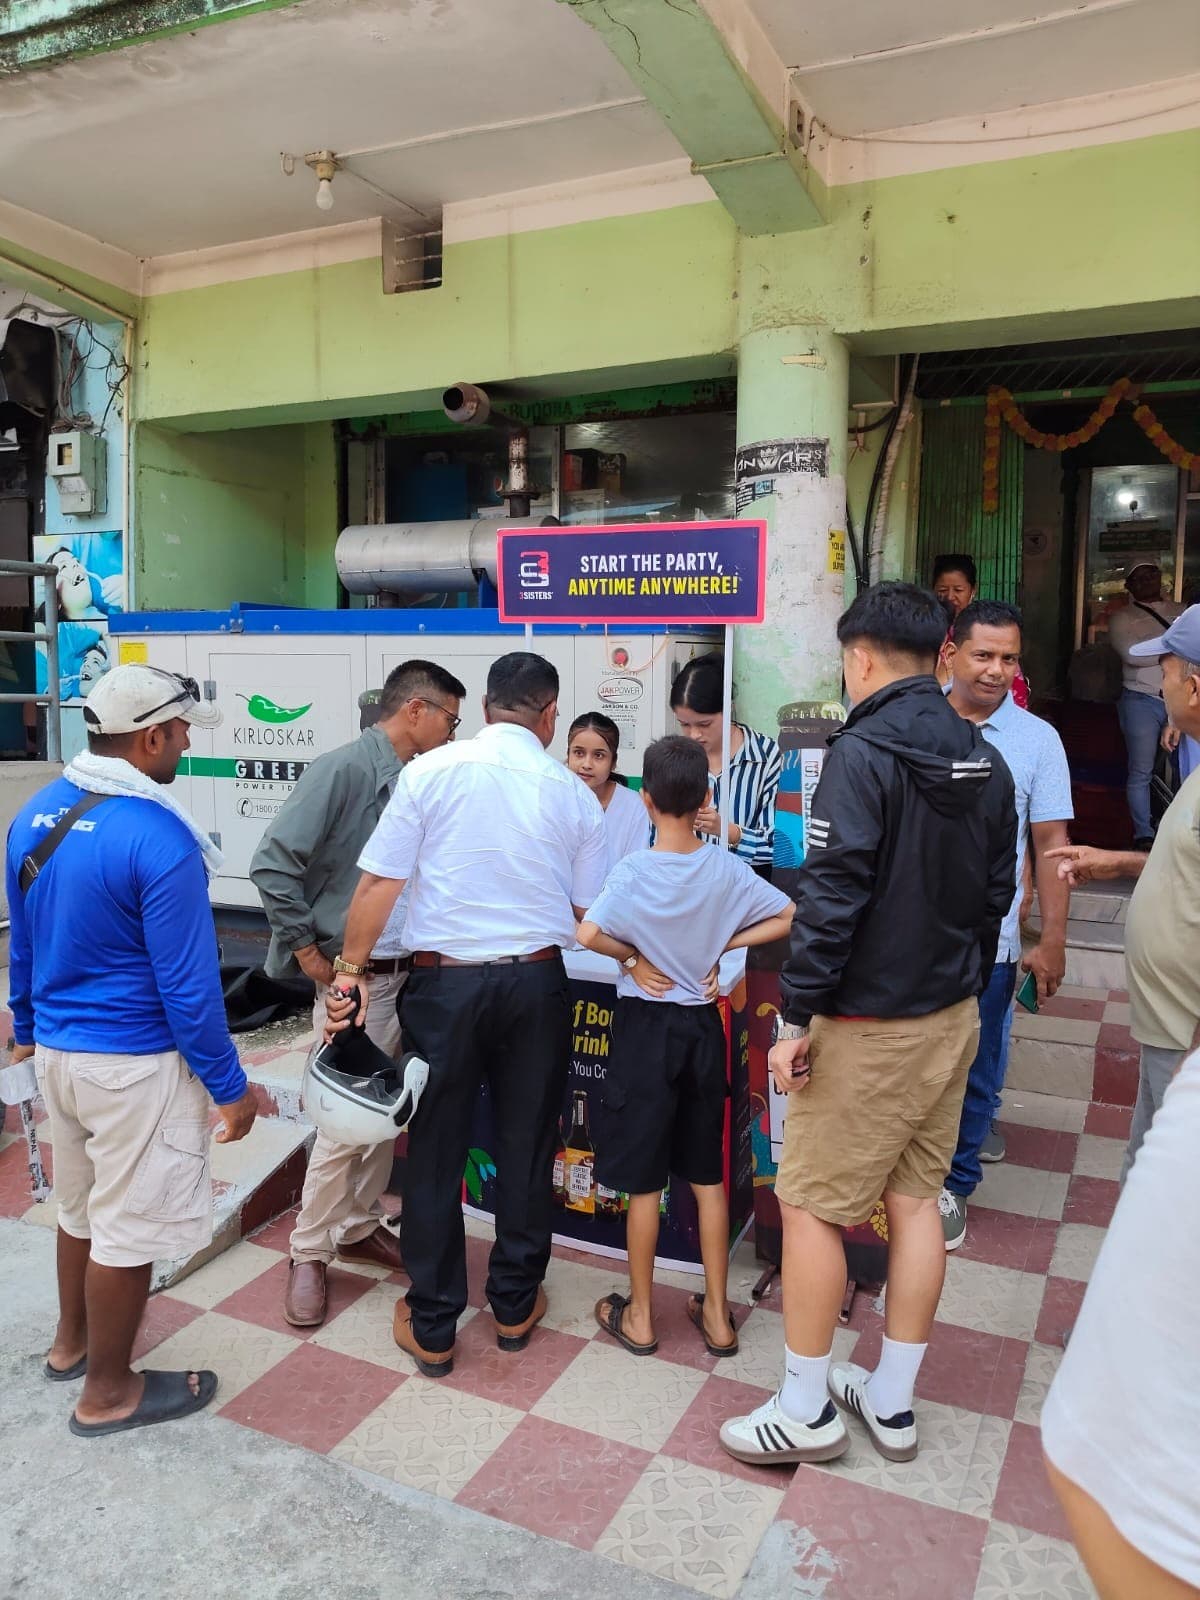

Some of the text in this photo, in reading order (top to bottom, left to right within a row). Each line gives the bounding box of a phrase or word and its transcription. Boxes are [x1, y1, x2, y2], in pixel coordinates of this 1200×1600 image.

[580, 551, 723, 575] START THE PARTY,
[568, 575, 738, 596] ANYTIME ANYWHERE!
[233, 727, 315, 747] KIRLOSKAR
[235, 761, 309, 780] GREE
[235, 782, 275, 791] POWER
[255, 804, 272, 814] 1800
[572, 1000, 614, 1029] f Bo
[572, 1030, 609, 1057] rink
[573, 1060, 592, 1078] You
